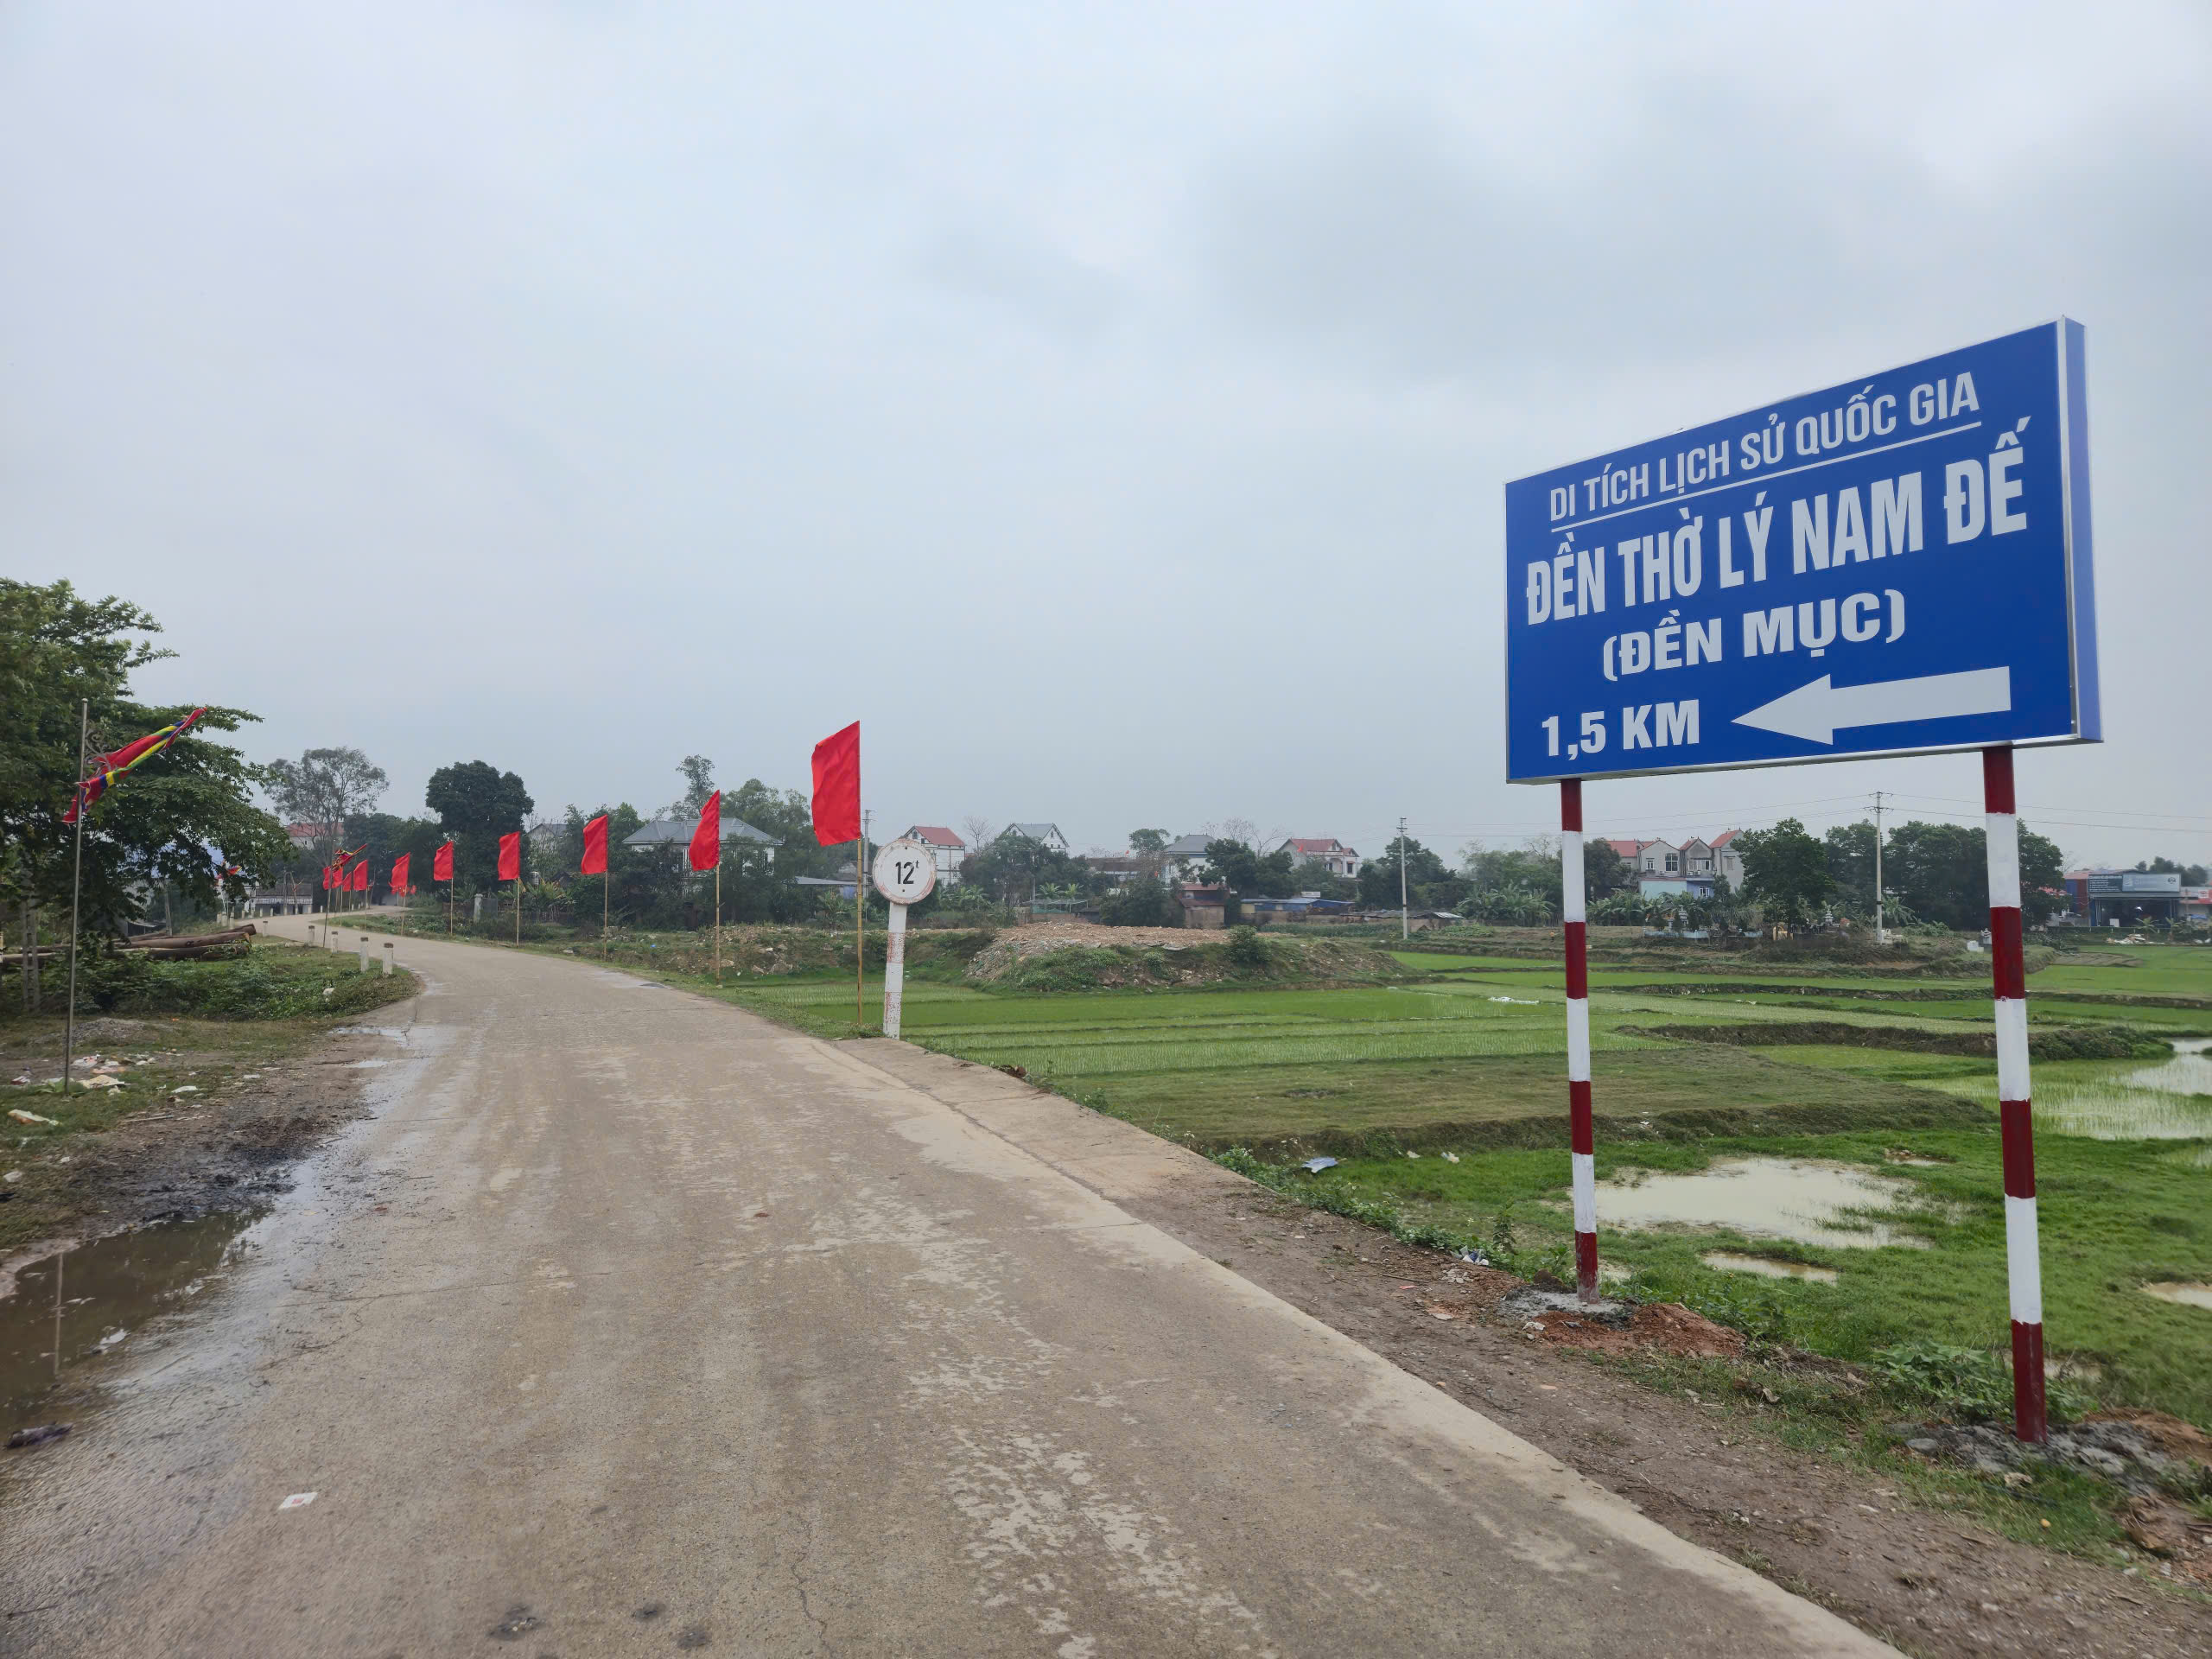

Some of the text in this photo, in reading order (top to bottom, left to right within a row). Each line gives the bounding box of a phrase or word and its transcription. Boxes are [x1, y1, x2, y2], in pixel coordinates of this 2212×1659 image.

[1551, 372, 1979, 521] DI TÍCH LỊCH SỬ QUỐC GIA
[1527, 416, 2031, 625] ĐỀN THỜ LÝ NAM ĐẾ
[1604, 589, 1905, 681] (ĐỀN MỤC)
[1542, 700, 1700, 760] 1,5 KM
